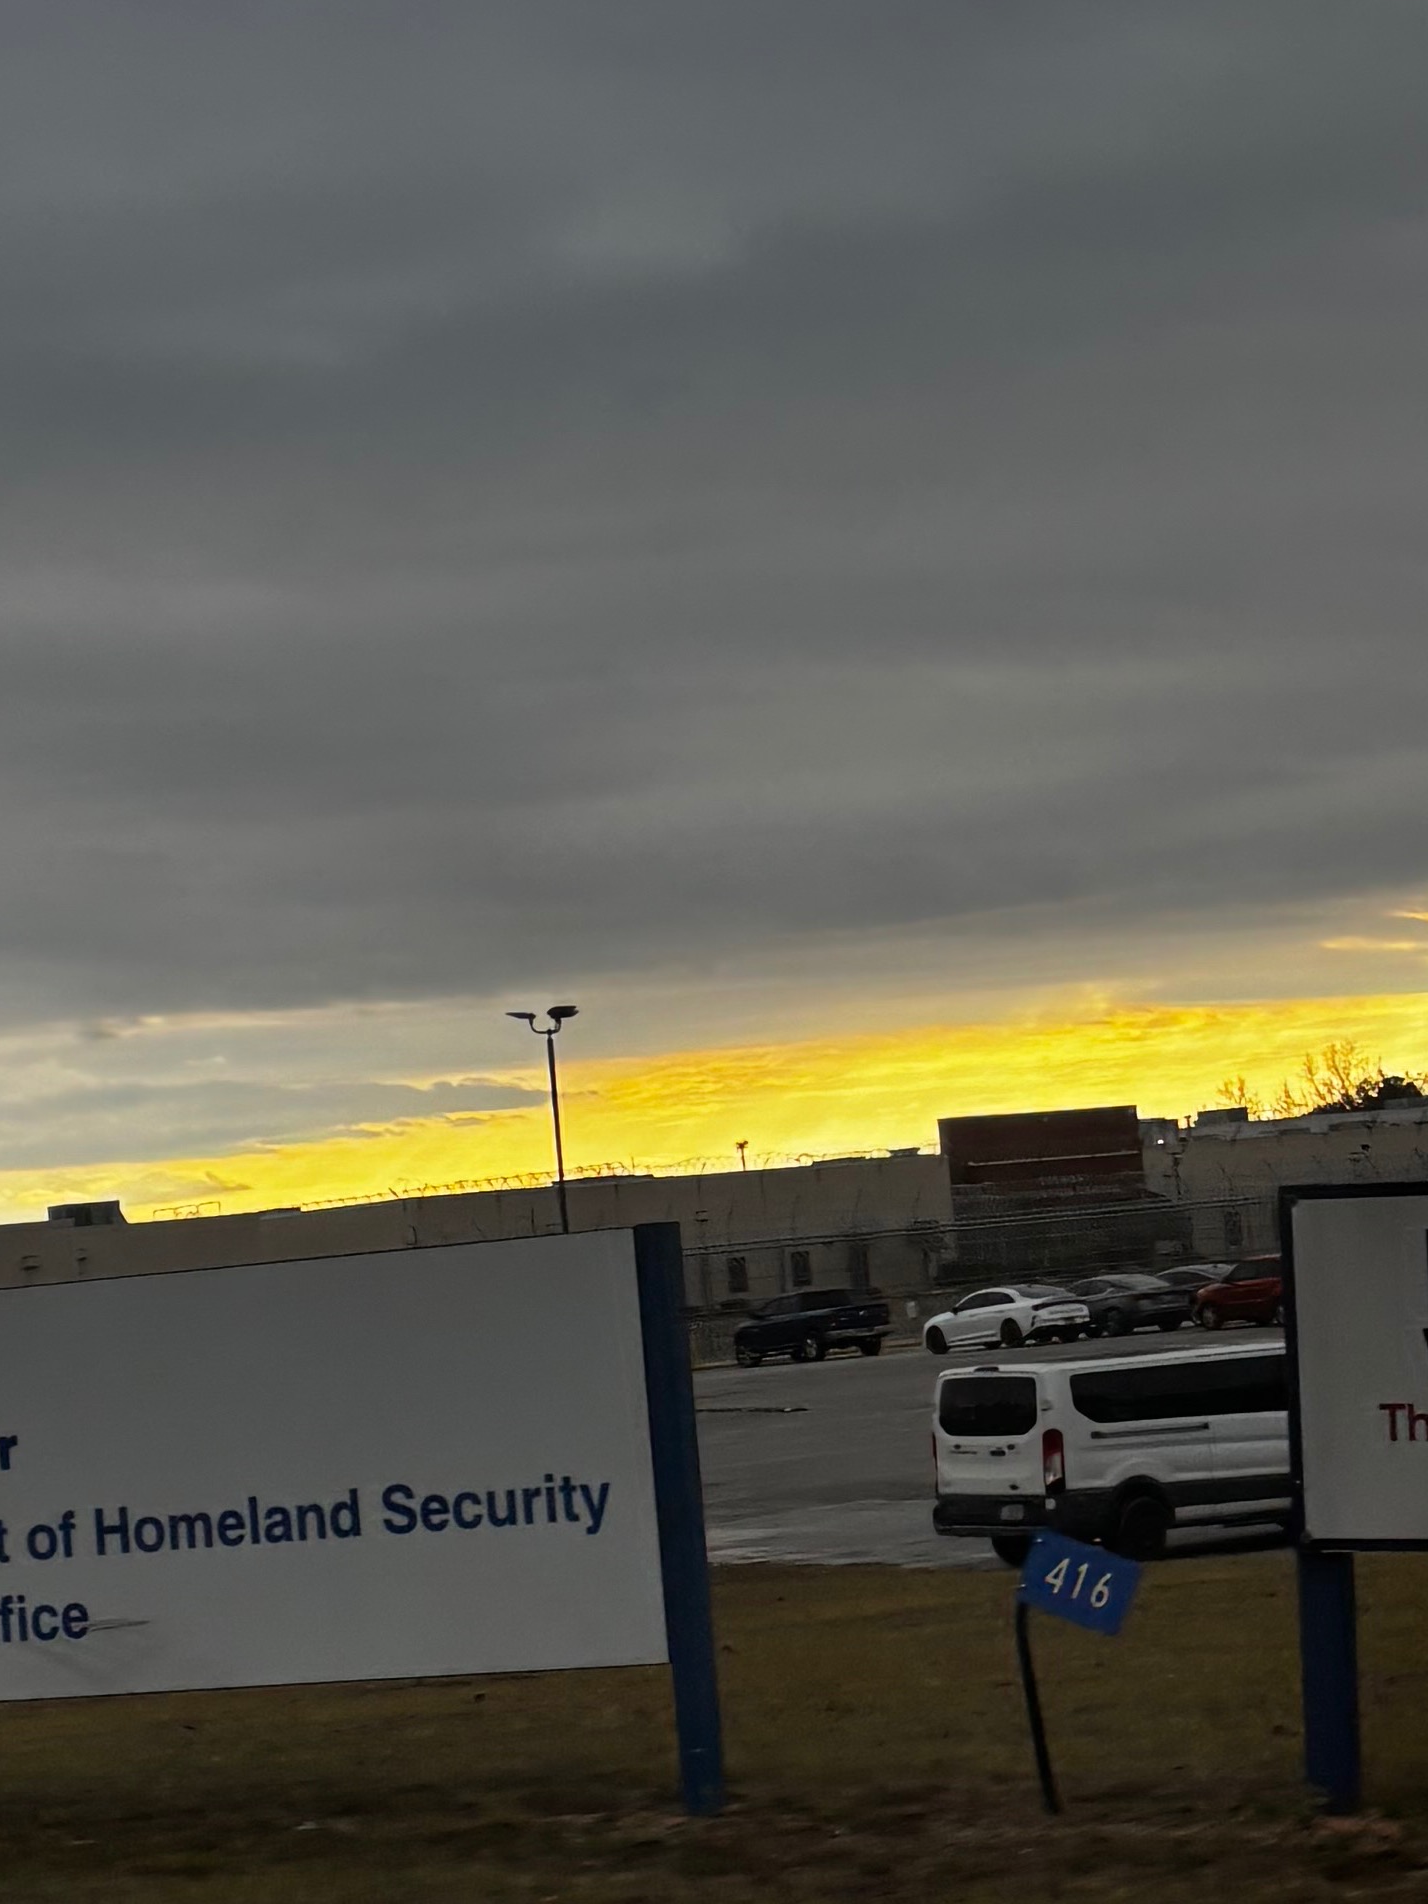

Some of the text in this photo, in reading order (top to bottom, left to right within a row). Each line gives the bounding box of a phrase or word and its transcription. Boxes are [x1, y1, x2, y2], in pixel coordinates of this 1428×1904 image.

[27, 1510, 76, 1560] of
[95, 1488, 361, 1555] Homeland
[382, 1474, 610, 1534] Security
[1045, 1557, 1112, 1608] 416
